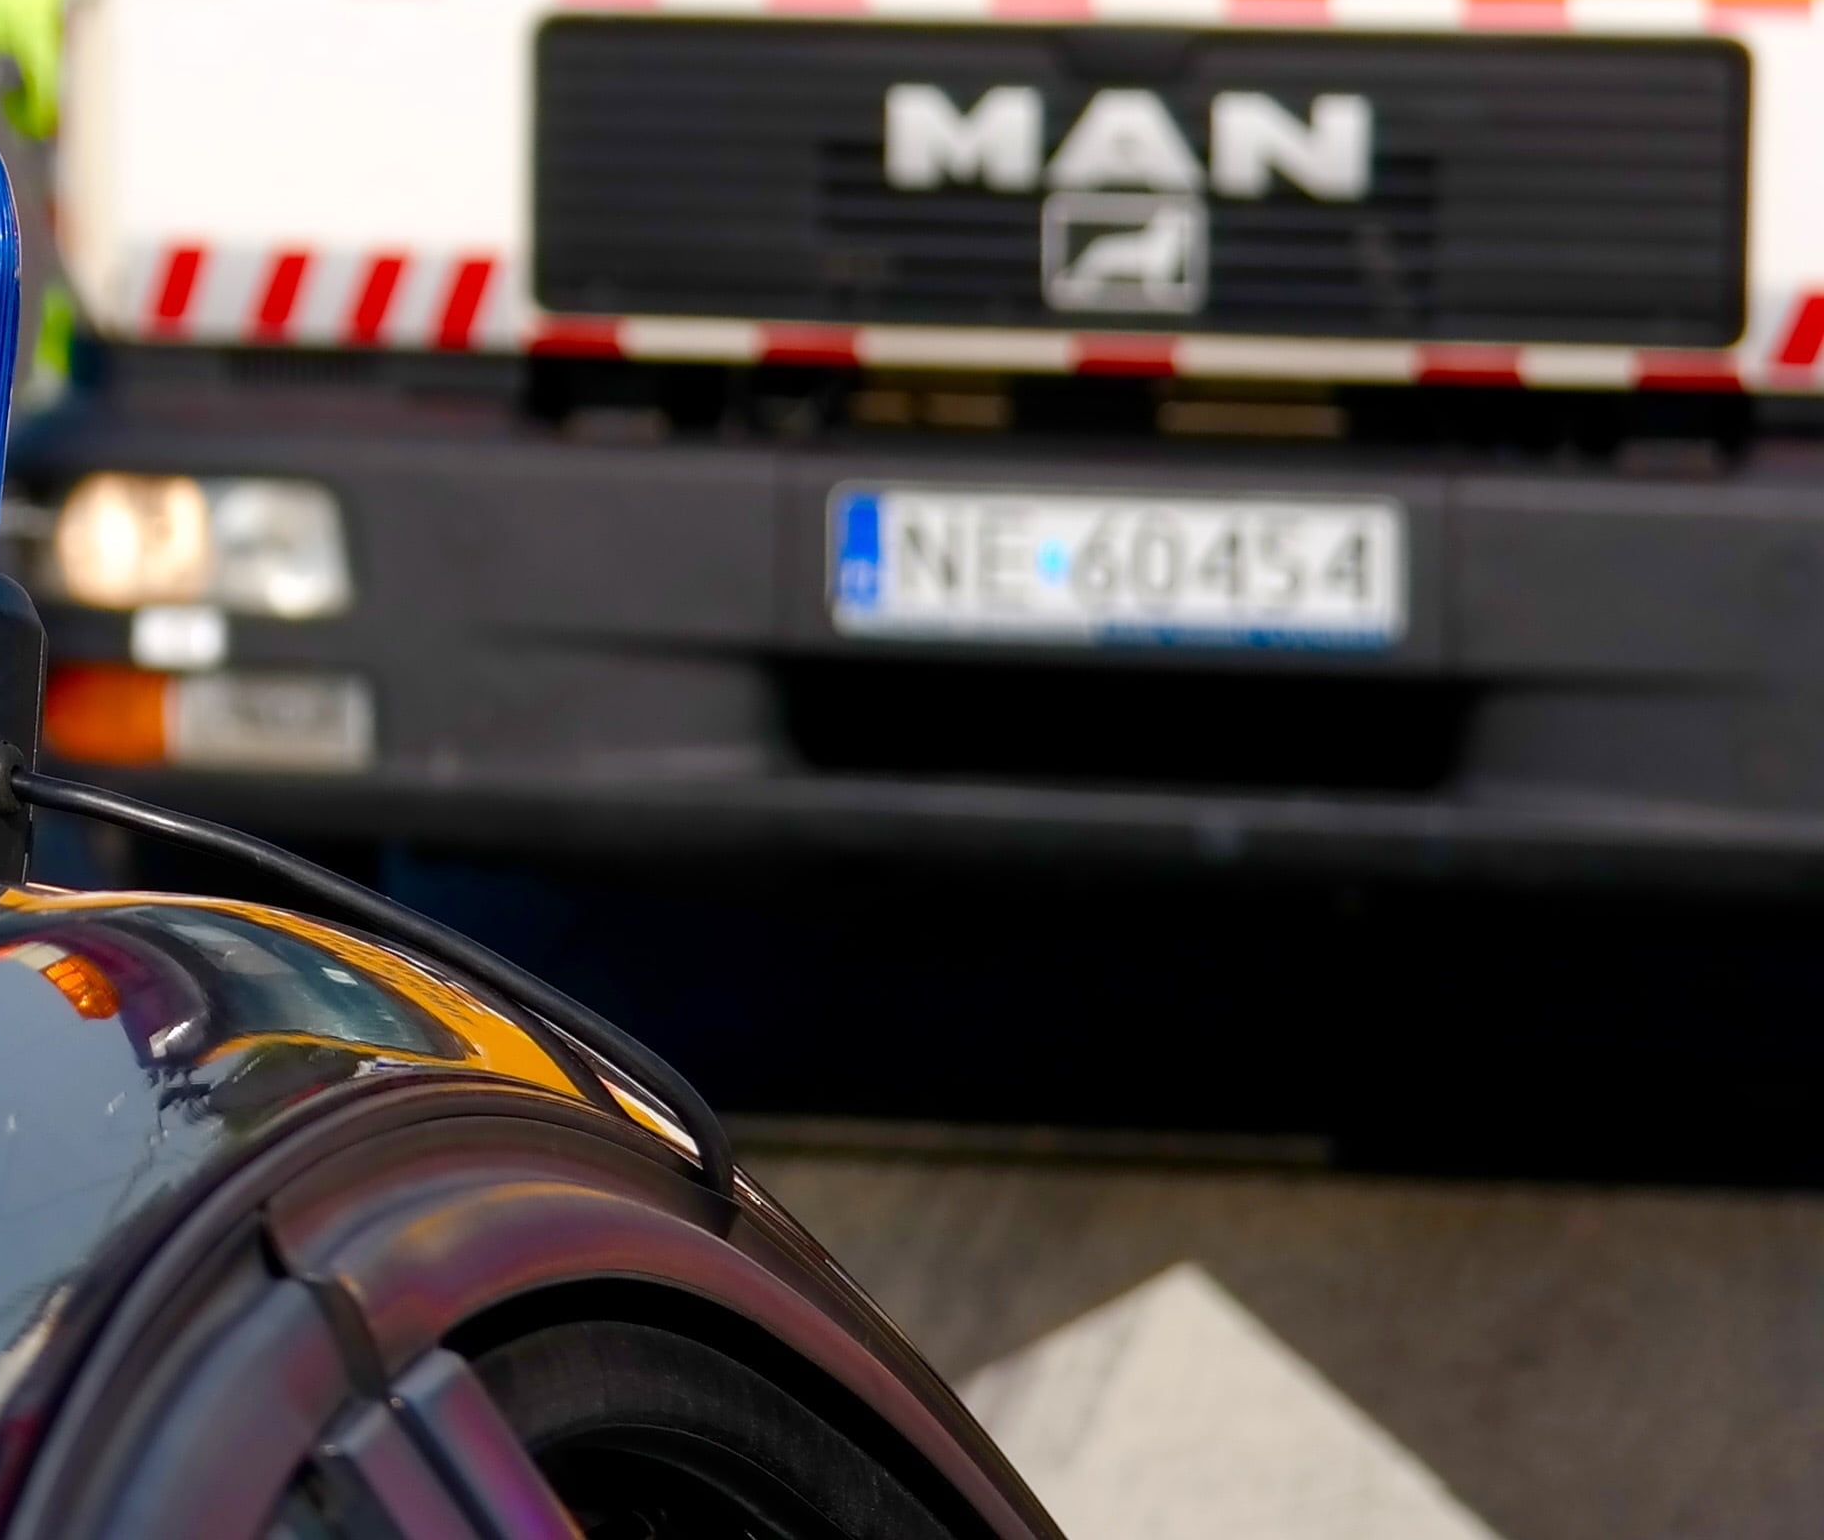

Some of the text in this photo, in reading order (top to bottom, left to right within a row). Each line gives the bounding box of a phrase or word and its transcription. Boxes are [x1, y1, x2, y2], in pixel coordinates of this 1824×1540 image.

[884, 82, 1373, 200] MAN
[901, 506, 1372, 610] NE 60454
